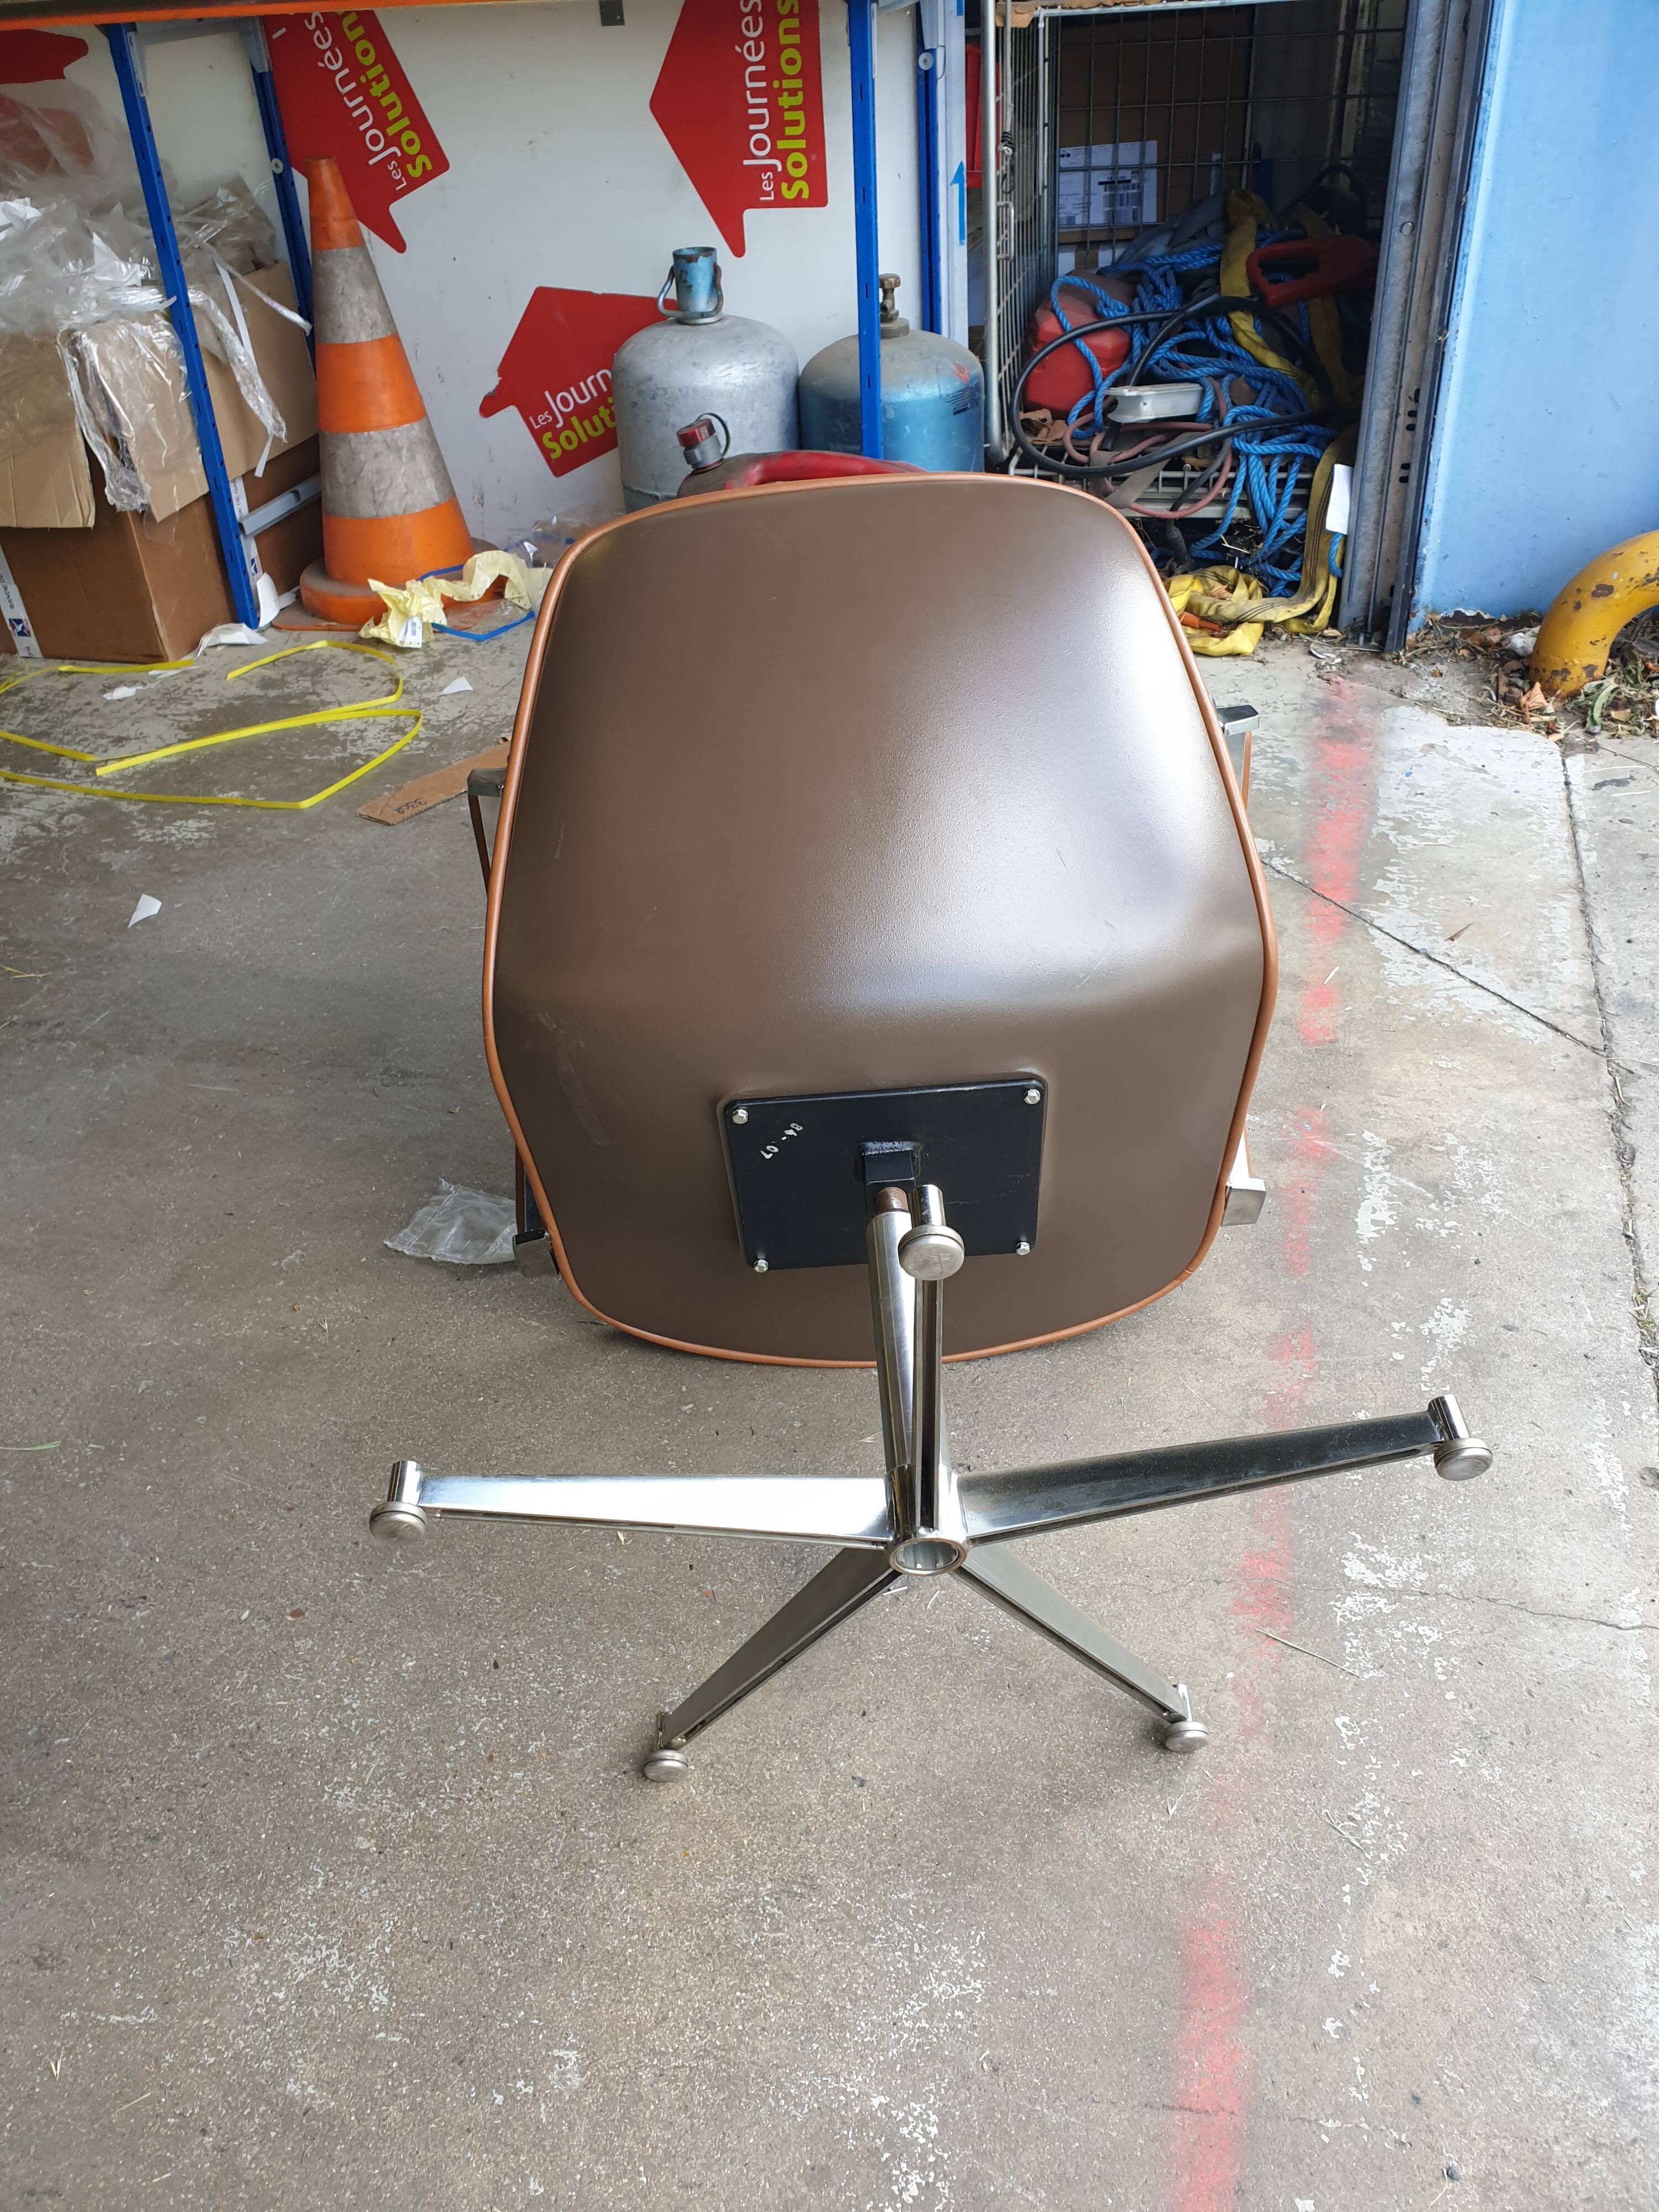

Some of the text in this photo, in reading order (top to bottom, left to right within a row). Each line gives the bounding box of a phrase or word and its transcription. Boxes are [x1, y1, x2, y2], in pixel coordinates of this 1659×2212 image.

[305, 11, 407, 190] Les Journées
[336, 11, 432, 178] Solution
[735, 0, 782, 201] Les Journées
[773, 0, 810, 200] Solutions
[528, 410, 553, 430] Les
[542, 397, 616, 460] Solut
